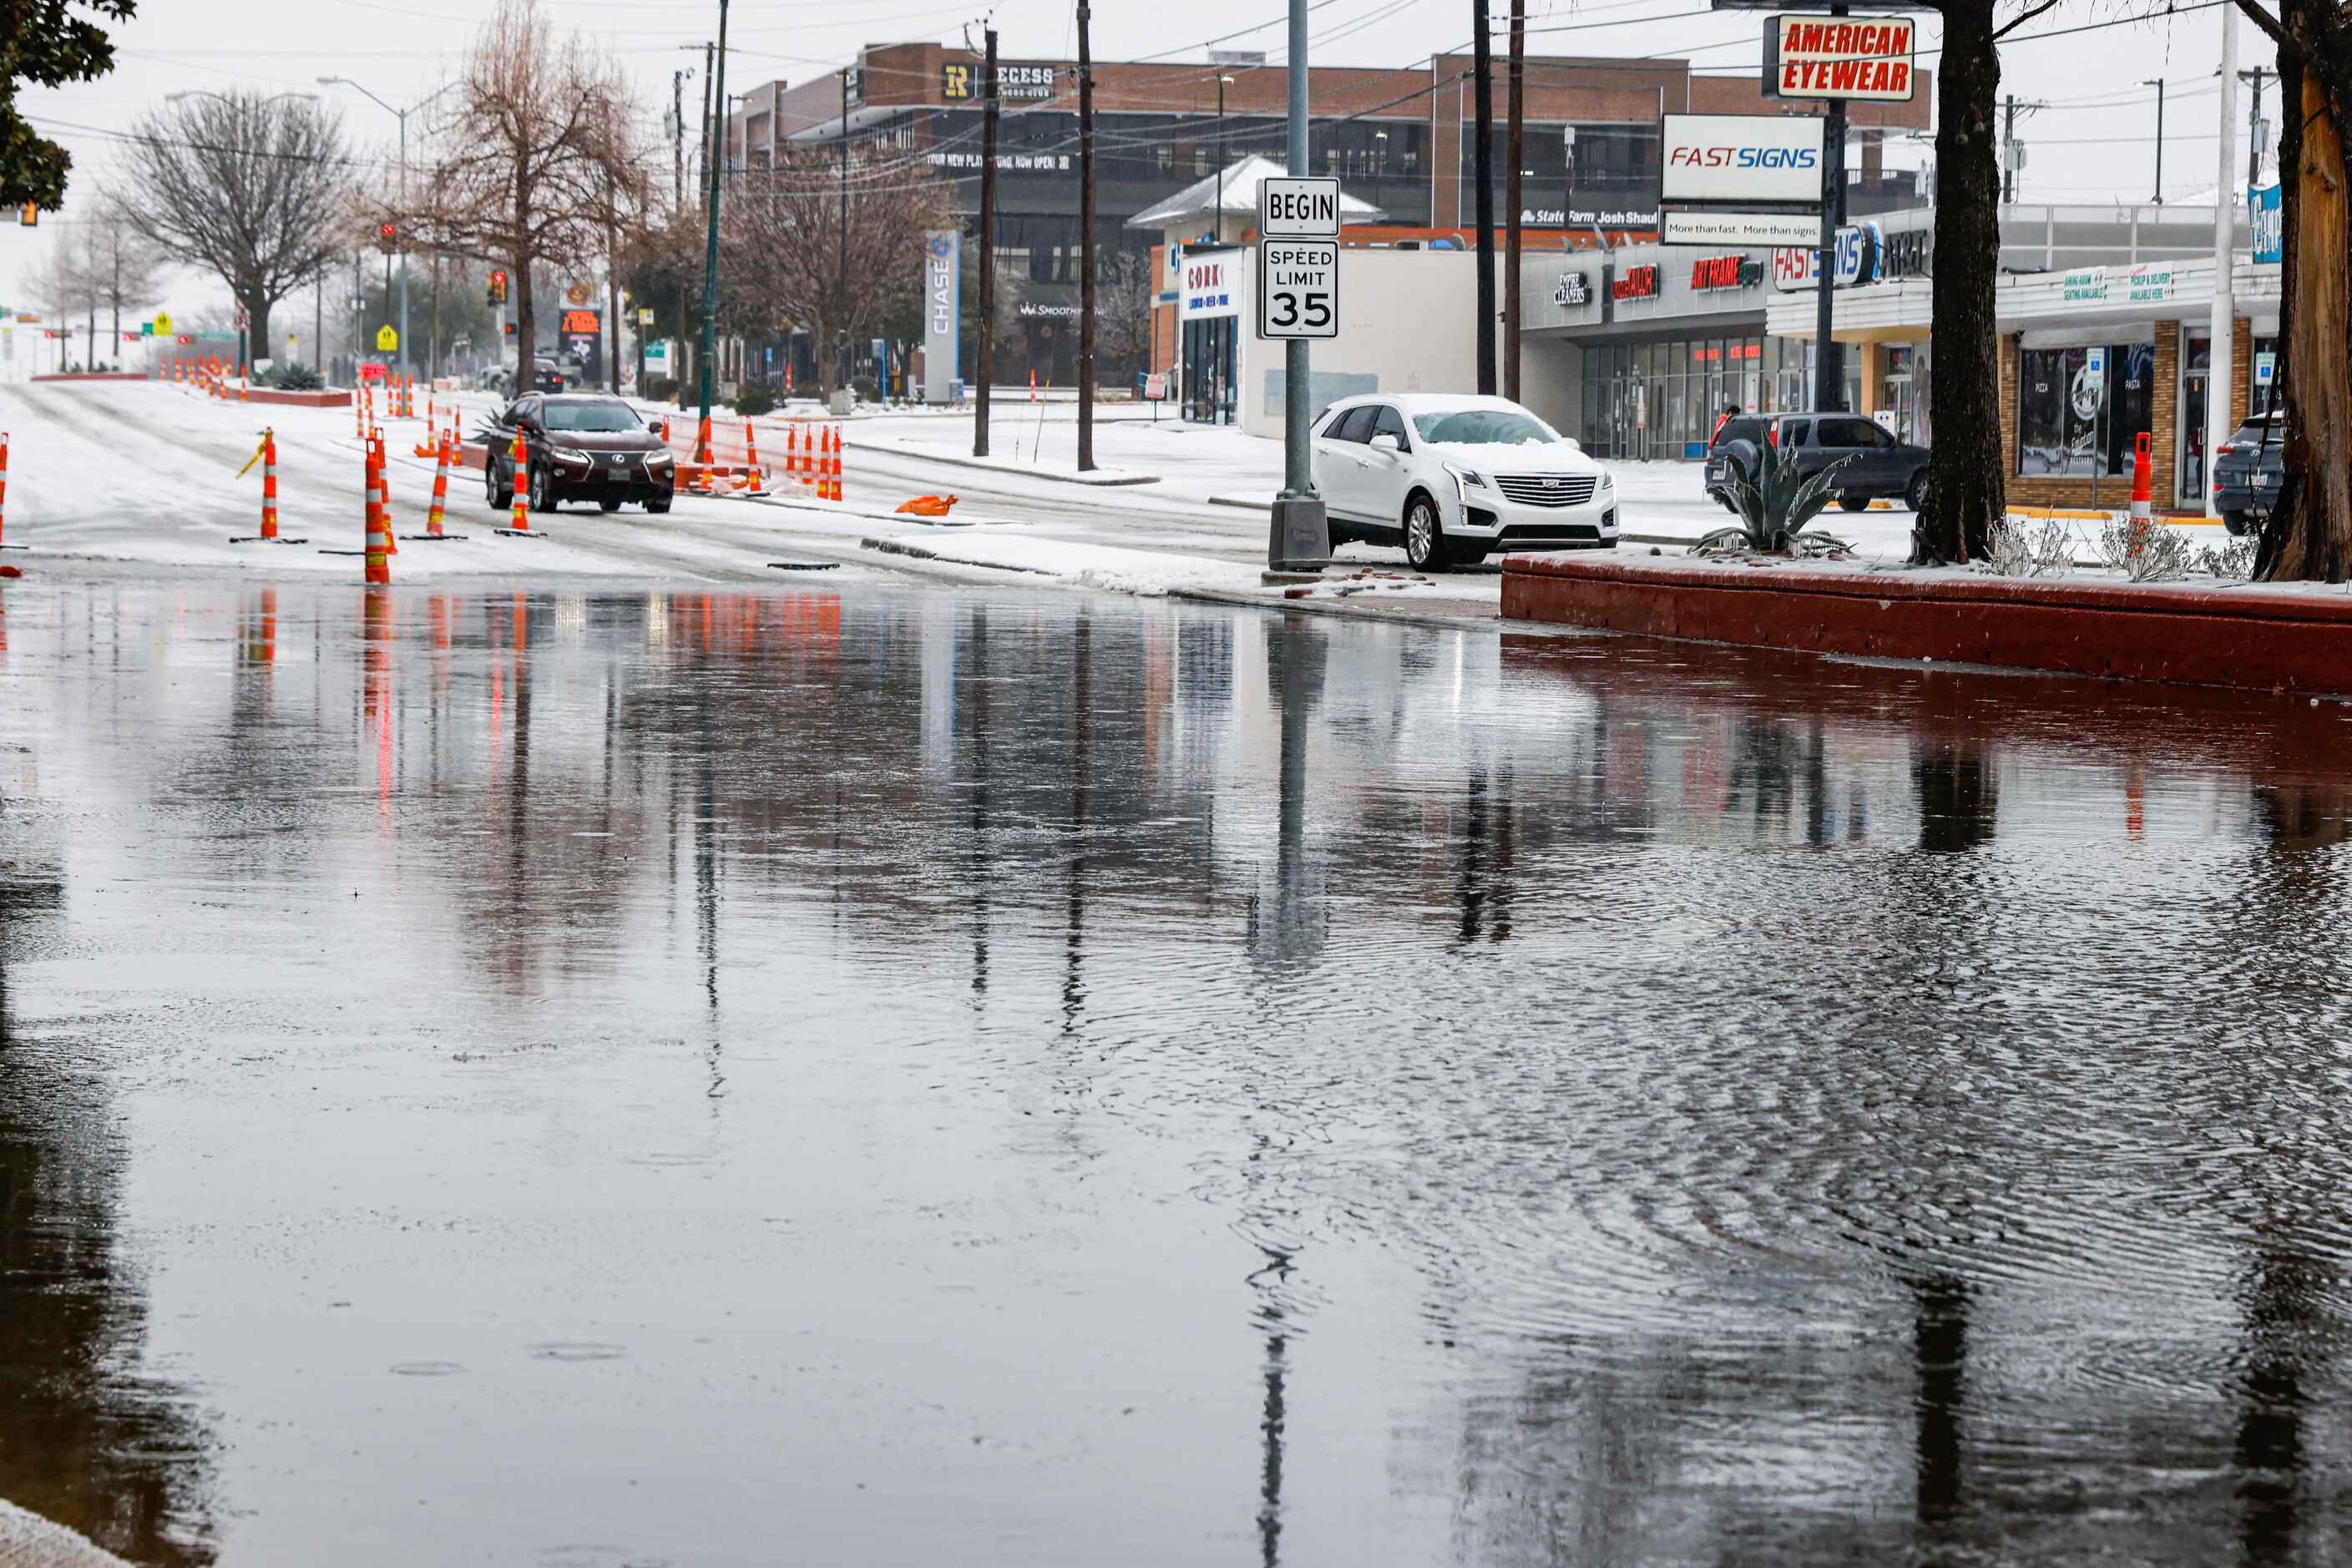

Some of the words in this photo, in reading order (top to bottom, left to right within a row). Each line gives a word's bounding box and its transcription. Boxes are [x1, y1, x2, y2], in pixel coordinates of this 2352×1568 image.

[1783, 23, 1909, 55] AMERICAN
[996, 67, 1054, 84] ECESS
[1783, 59, 1909, 92] EYEWEAR
[927, 153, 946, 166] YOUR
[947, 154, 965, 168] NEW
[1015, 155, 1033, 169] NOW
[1670, 147, 1817, 169] FASTSIGNS
[1270, 194, 1333, 220] BEGIN
[1536, 210, 1565, 224] State
[1569, 210, 1595, 223] Farm
[1597, 211, 1625, 225] Josh
[1669, 224, 1693, 234] More
[1696, 224, 1717, 234] than
[1718, 225, 1739, 235] fast.
[1743, 225, 1768, 235] More
[1769, 225, 1791, 235] than
[1270, 250, 1333, 266] SPEED
[1188, 265, 1219, 289] CORK
[1276, 272, 1325, 286] LIMIT
[1559, 274, 1580, 289] EMPIRE
[933, 260, 949, 335] CHASE
[1554, 287, 1585, 306] CLEANERS
[1037, 305, 1083, 316] SMOOTH
[1271, 292, 1331, 327] 35
[2035, 382, 2049, 393] PIZZA
[2125, 380, 2141, 390] PASTA
